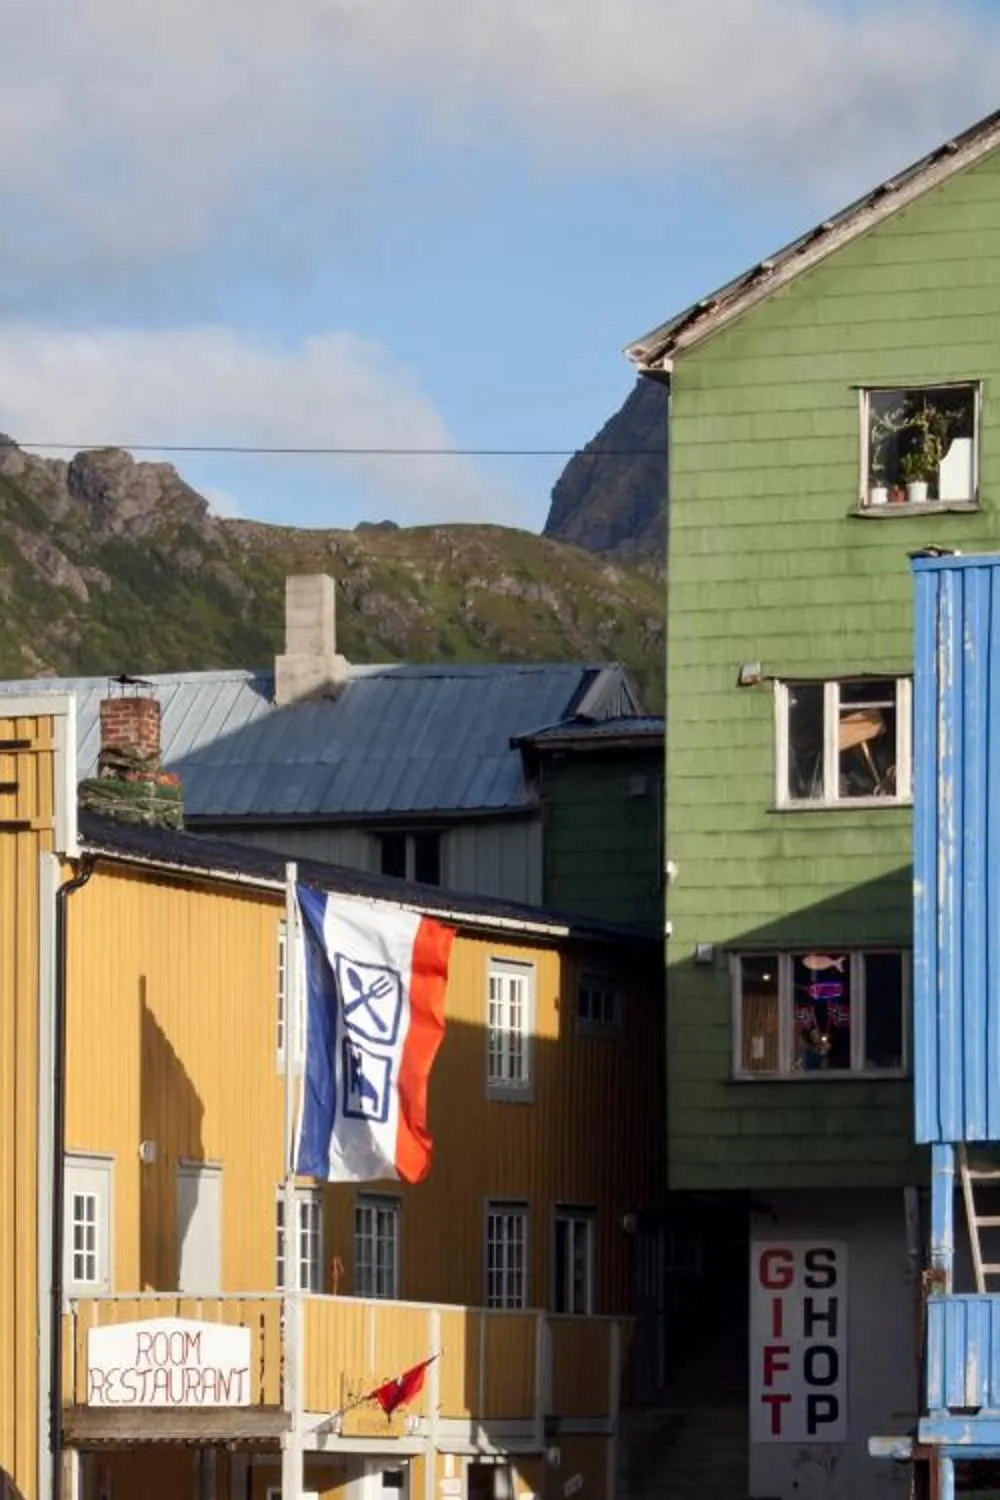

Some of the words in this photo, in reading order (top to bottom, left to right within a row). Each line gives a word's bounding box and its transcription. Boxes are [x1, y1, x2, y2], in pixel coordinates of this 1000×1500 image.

[88, 1367, 249, 1404] RESTAURANT
[135, 1330, 202, 1367] ROOM
[758, 1247, 795, 1435] GIFT
[802, 1247, 840, 1435] SHOP
